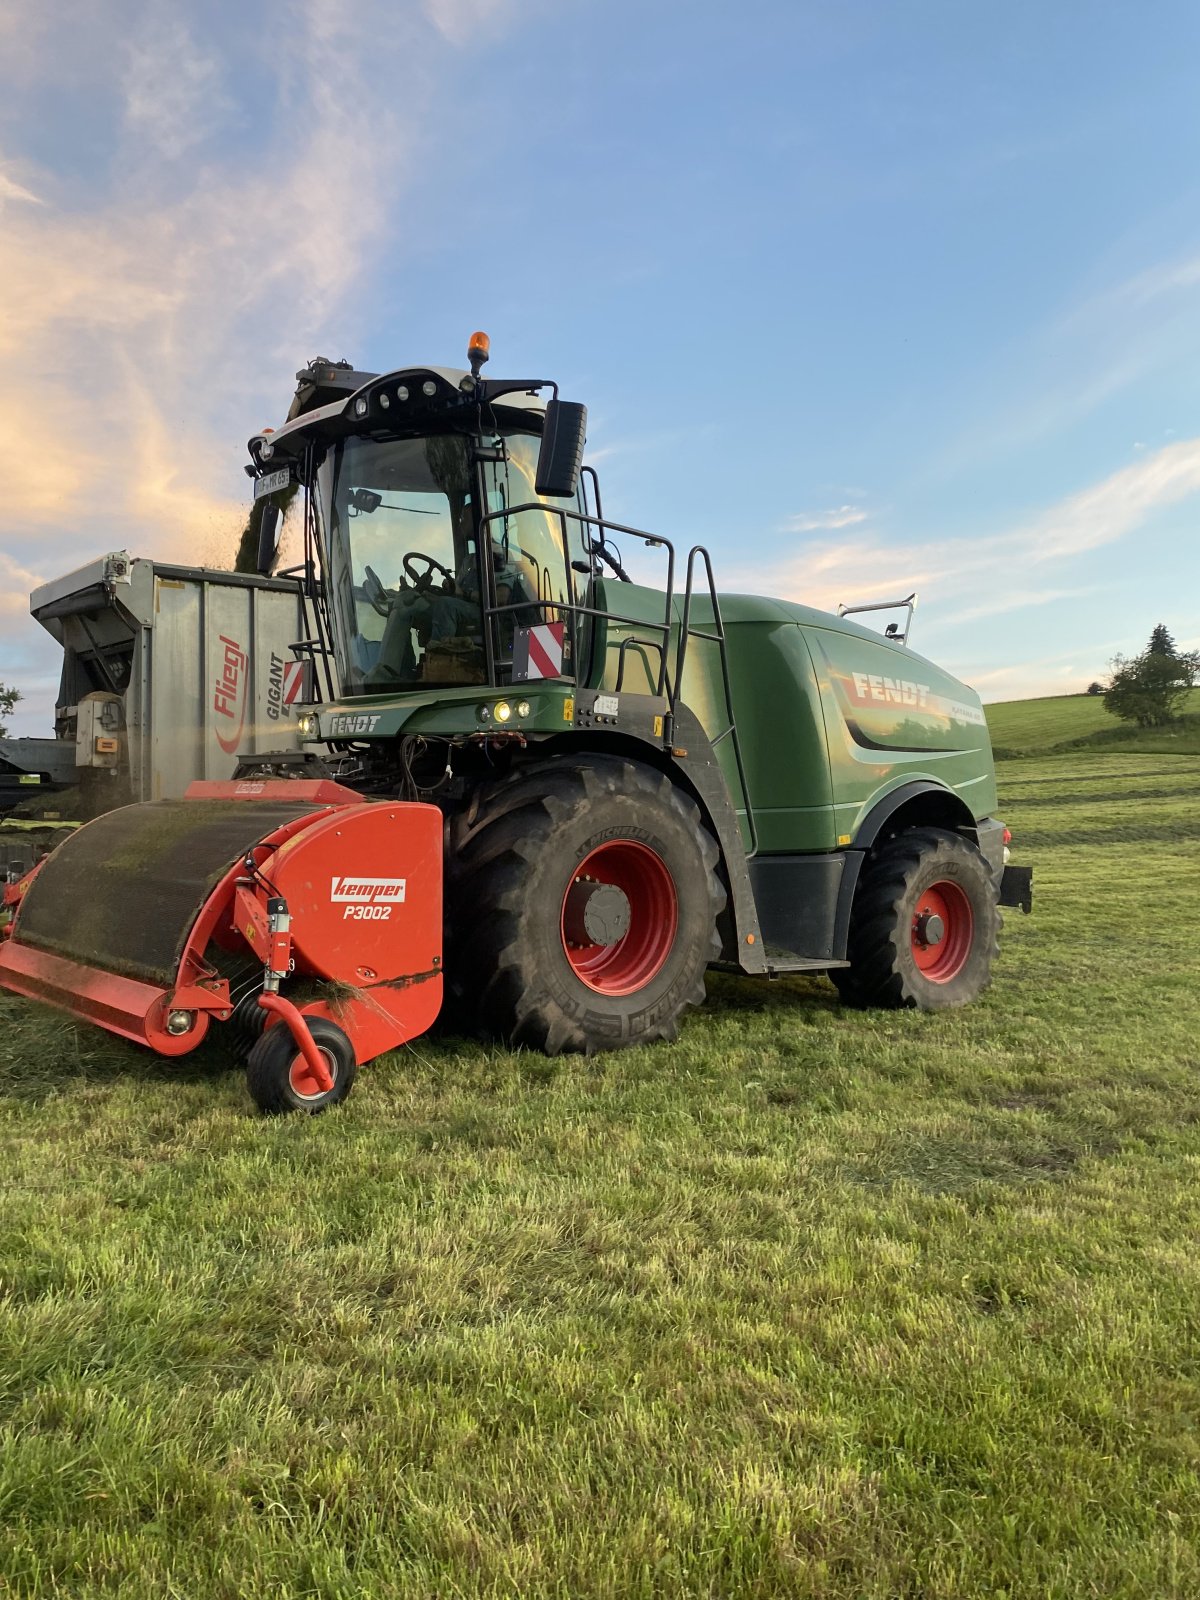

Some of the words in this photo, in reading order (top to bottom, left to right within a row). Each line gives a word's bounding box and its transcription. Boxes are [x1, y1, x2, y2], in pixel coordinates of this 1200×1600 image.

[214, 634, 245, 719] Fliegl
[266, 652, 284, 721] GIGANT
[852, 671, 930, 708] FENDT
[331, 715, 381, 735] FENDT
[333, 877, 402, 902] kemper
[343, 905, 392, 920] P3002
